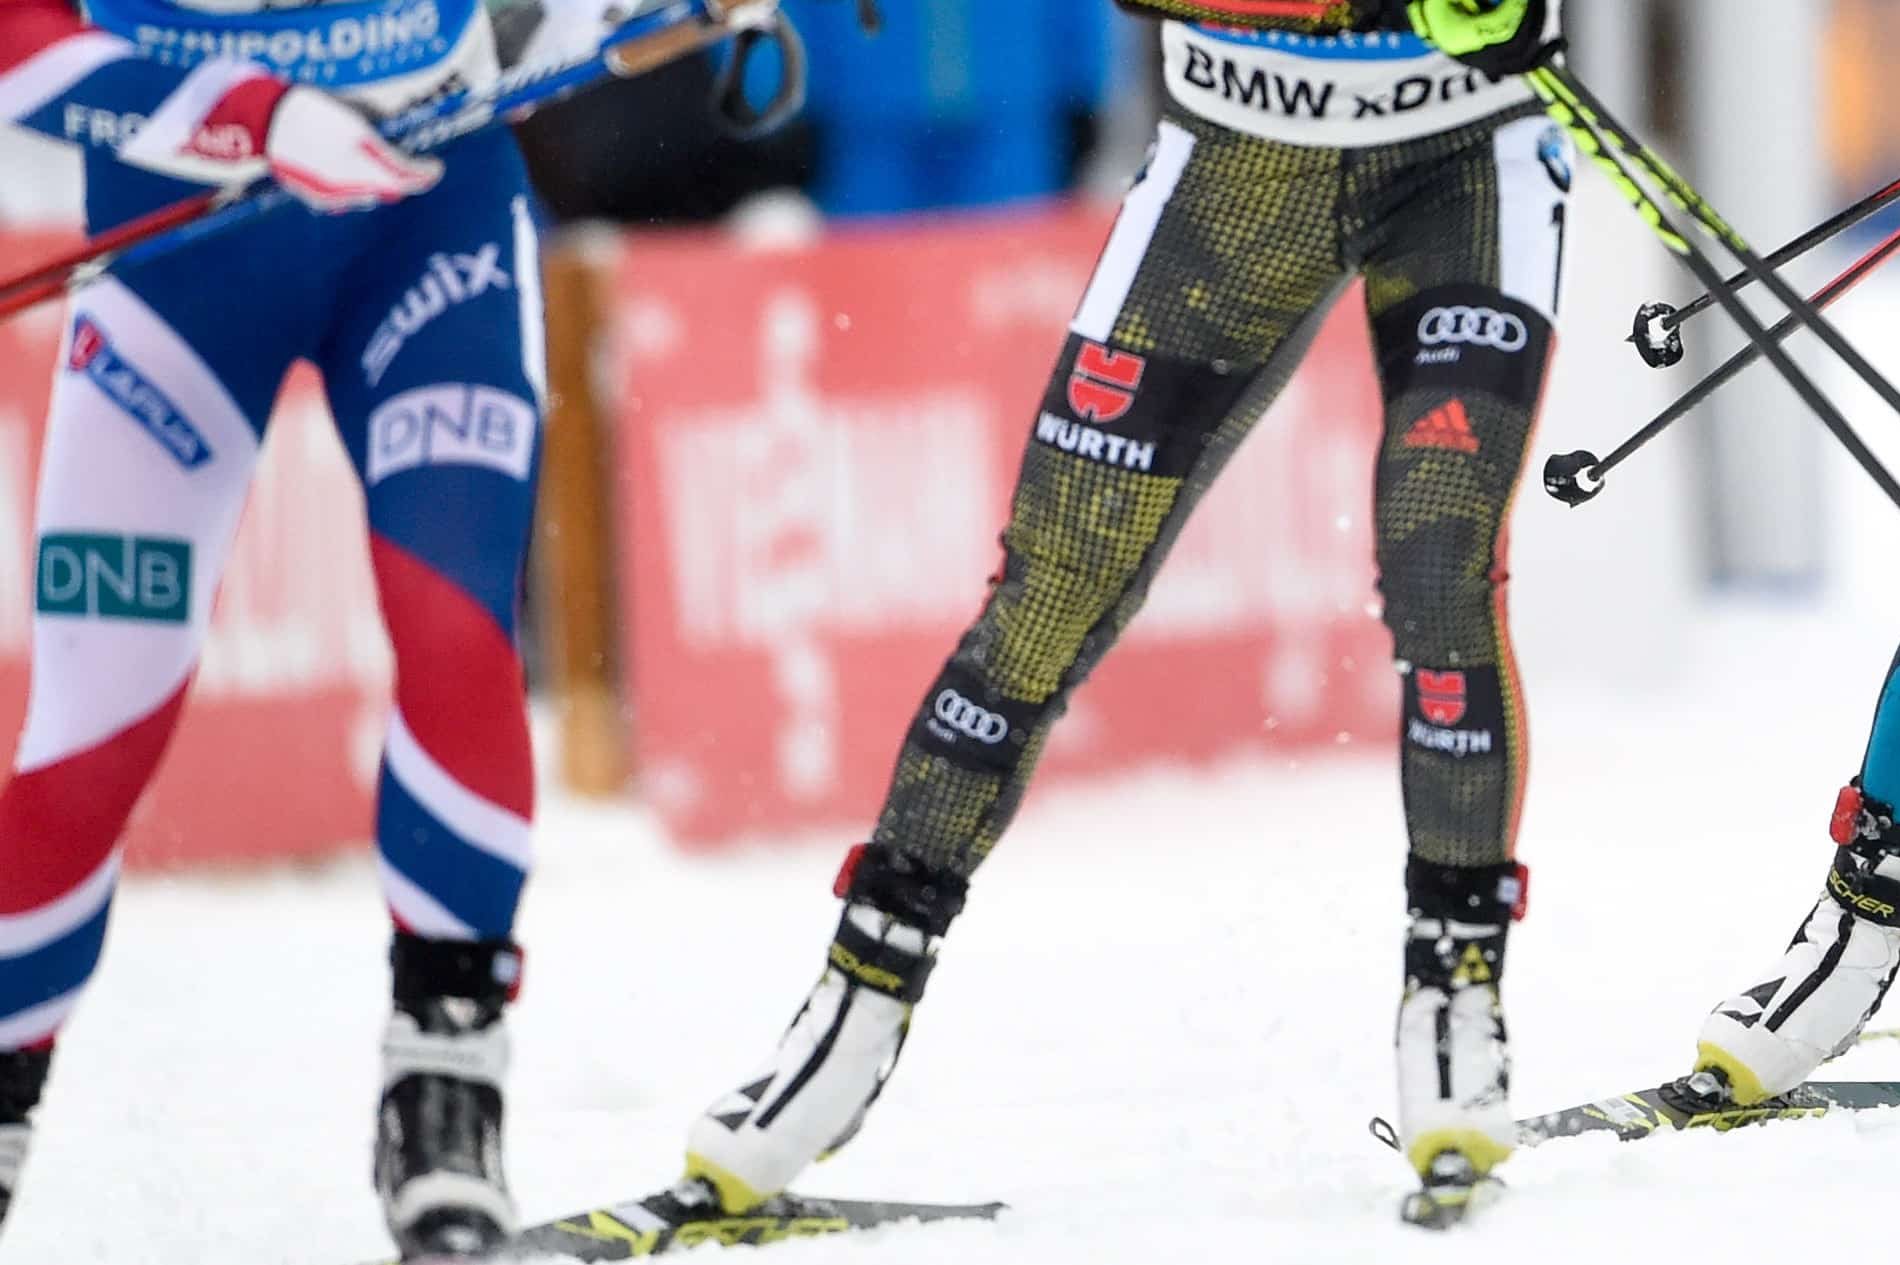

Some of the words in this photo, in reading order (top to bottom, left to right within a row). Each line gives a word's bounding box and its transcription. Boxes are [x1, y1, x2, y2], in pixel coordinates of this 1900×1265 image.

[1184, 41, 1333, 119] BMW
[377, 400, 515, 460] DNB
[40, 541, 183, 612] DNB
